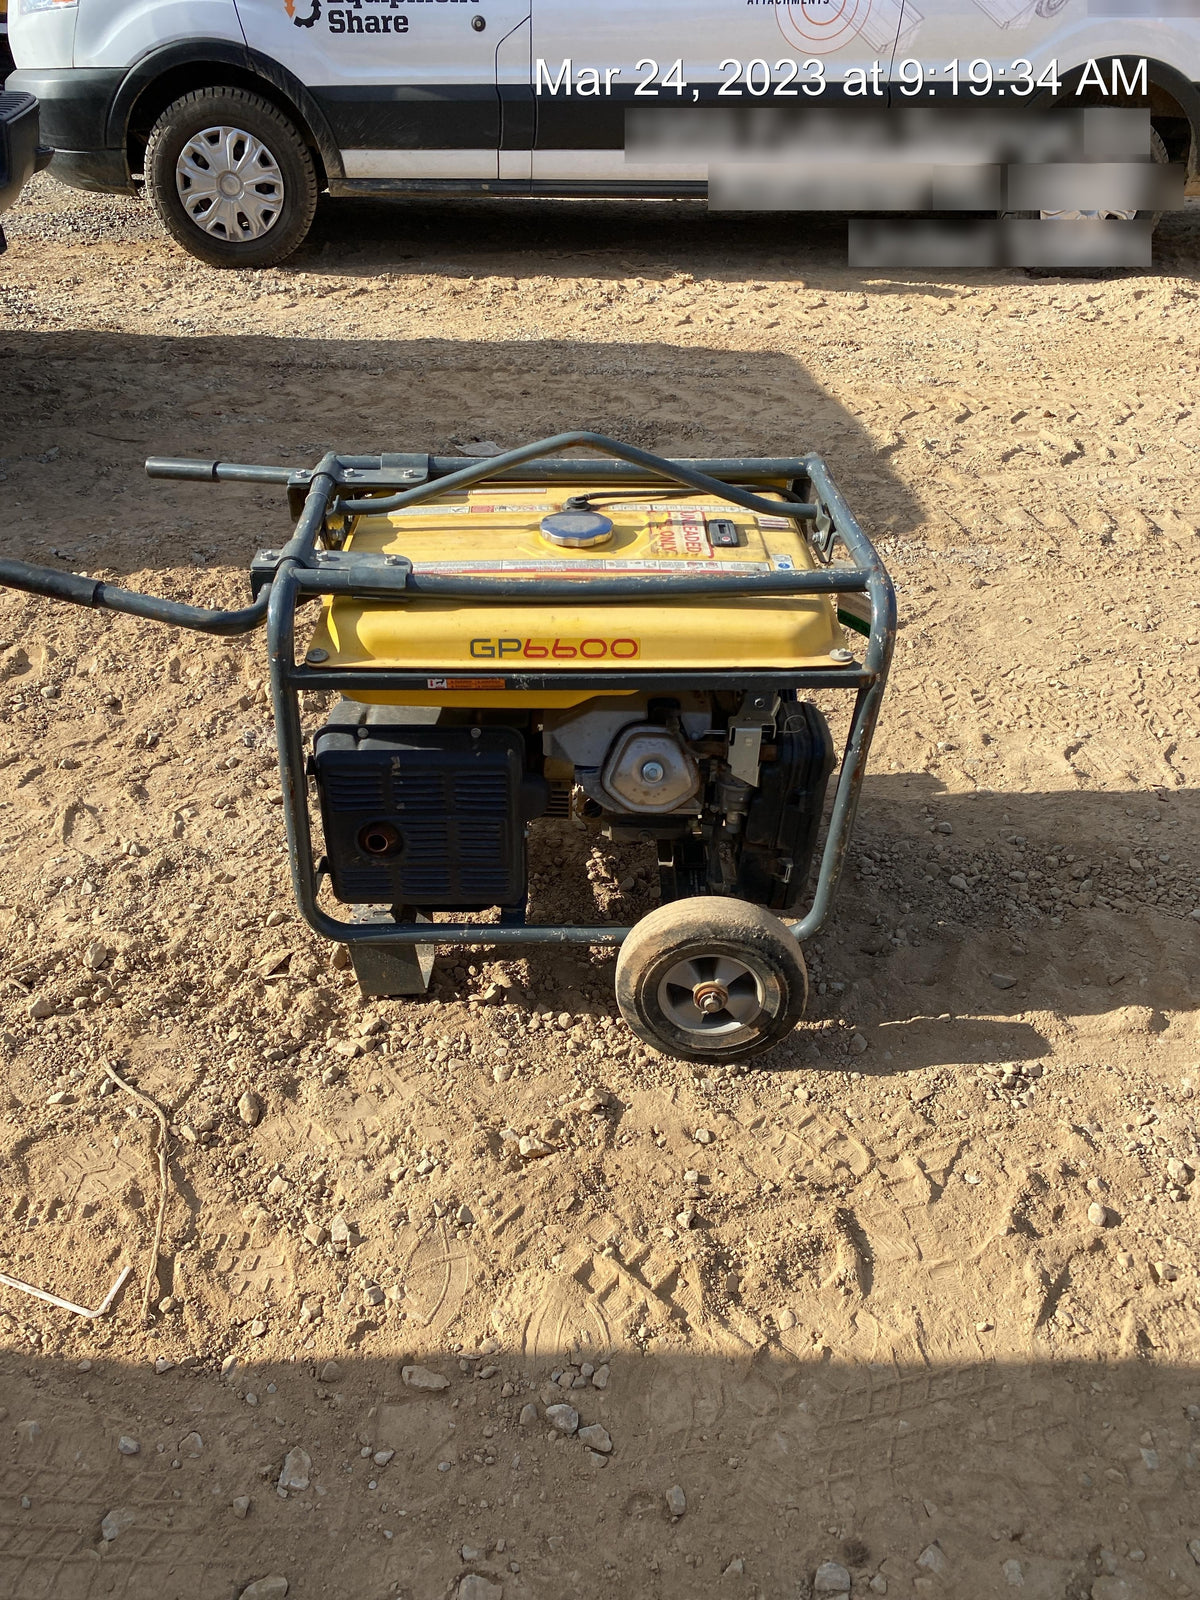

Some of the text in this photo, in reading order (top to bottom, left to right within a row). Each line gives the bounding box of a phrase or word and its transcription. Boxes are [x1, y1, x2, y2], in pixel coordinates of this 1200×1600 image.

[328, 10, 409, 33] Share
[660, 530, 677, 553] ONLY
[680, 511, 702, 552] UNLEADED
[469, 638, 639, 659] GP6600
